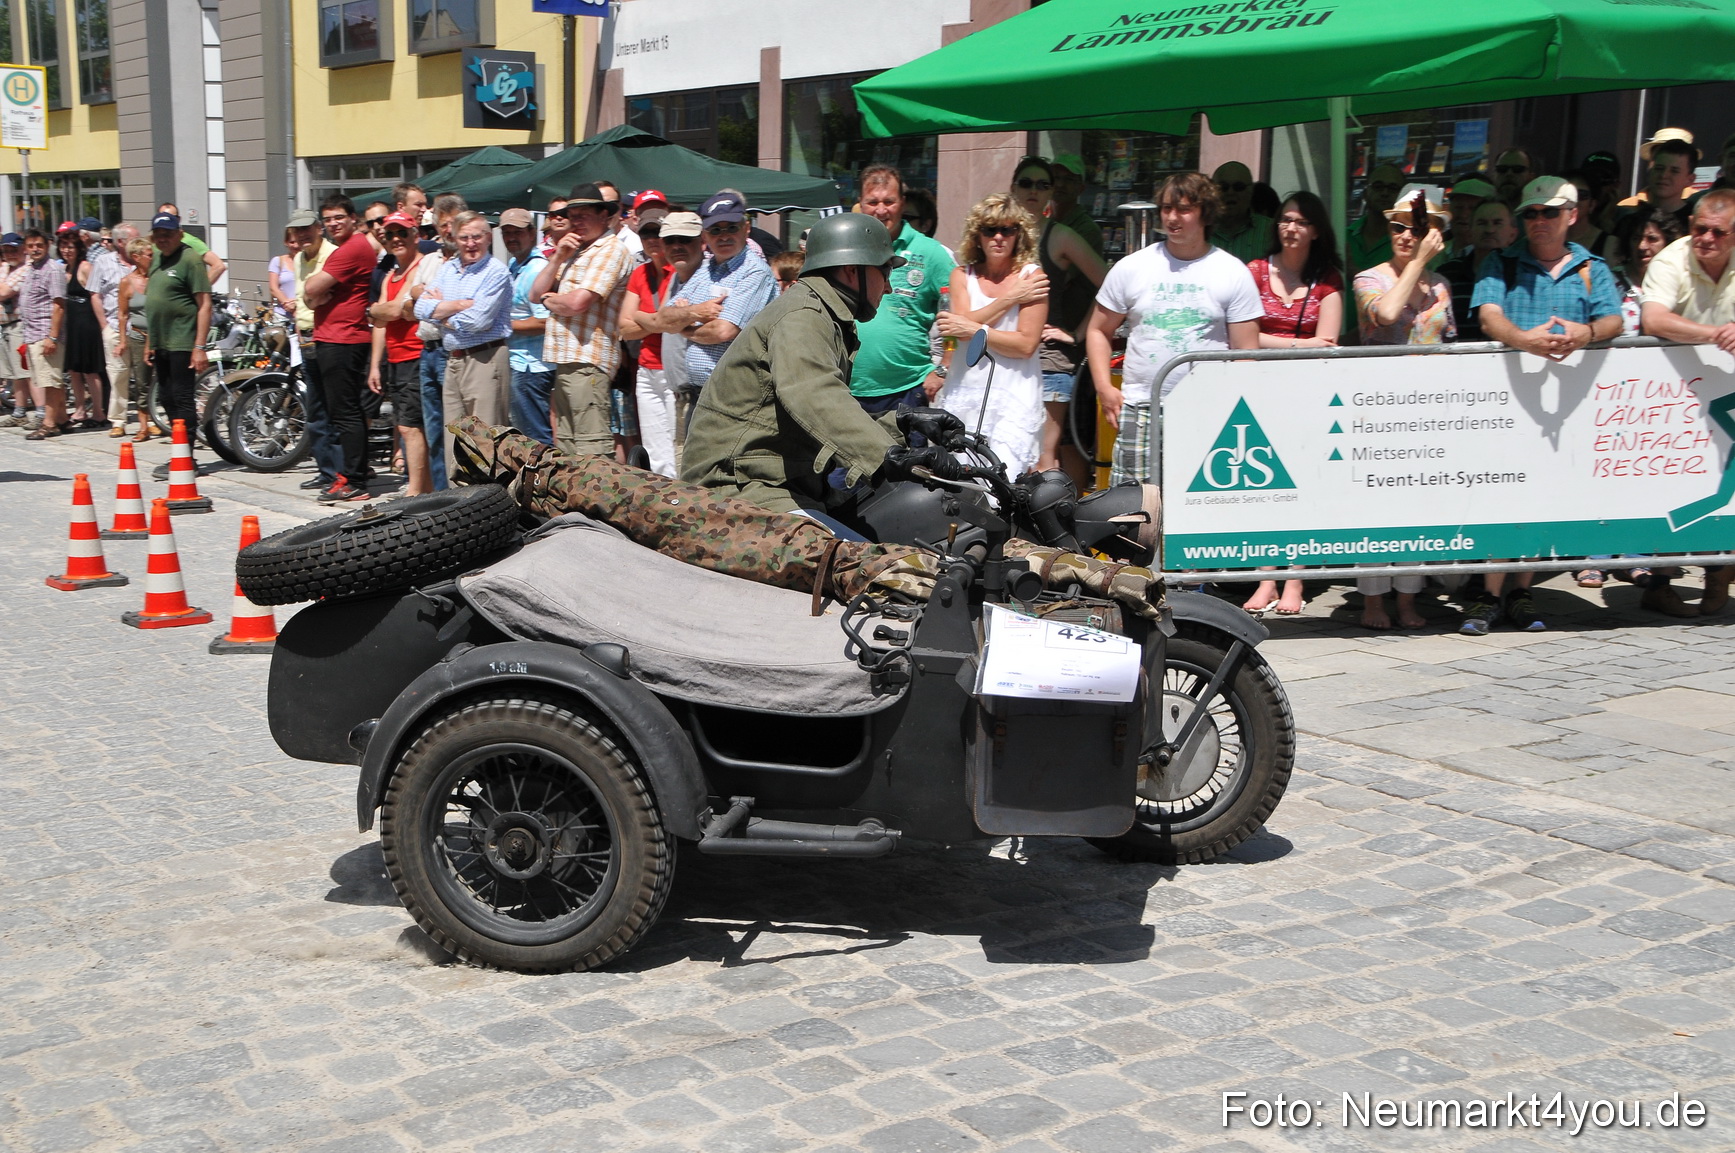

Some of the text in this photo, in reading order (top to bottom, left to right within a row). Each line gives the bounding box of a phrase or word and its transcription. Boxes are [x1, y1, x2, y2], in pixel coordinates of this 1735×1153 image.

[1109, 0, 1308, 27] Neumarkter
[1049, 10, 1334, 53] Lammsbräu
[616, 35, 669, 57] Unterer Markt 15
[13, 78, 29, 98] H
[493, 71, 518, 104] G2
[1352, 389, 1509, 406] Gebäudereinigung
[1645, 377, 1703, 398] UNS
[1352, 416, 1514, 434] Hausmeisterdienste
[1352, 445, 1445, 461] Mietservice
[1366, 471, 1526, 488] Event-Leit-Systeme
[1185, 497, 1202, 506] Jura
[1204, 495, 1240, 505] Gebäude
[1273, 494, 1298, 503] GmbH
[1183, 534, 1475, 562] www.jura-gebaeudeservice.de
[1057, 628, 1107, 643] 423
